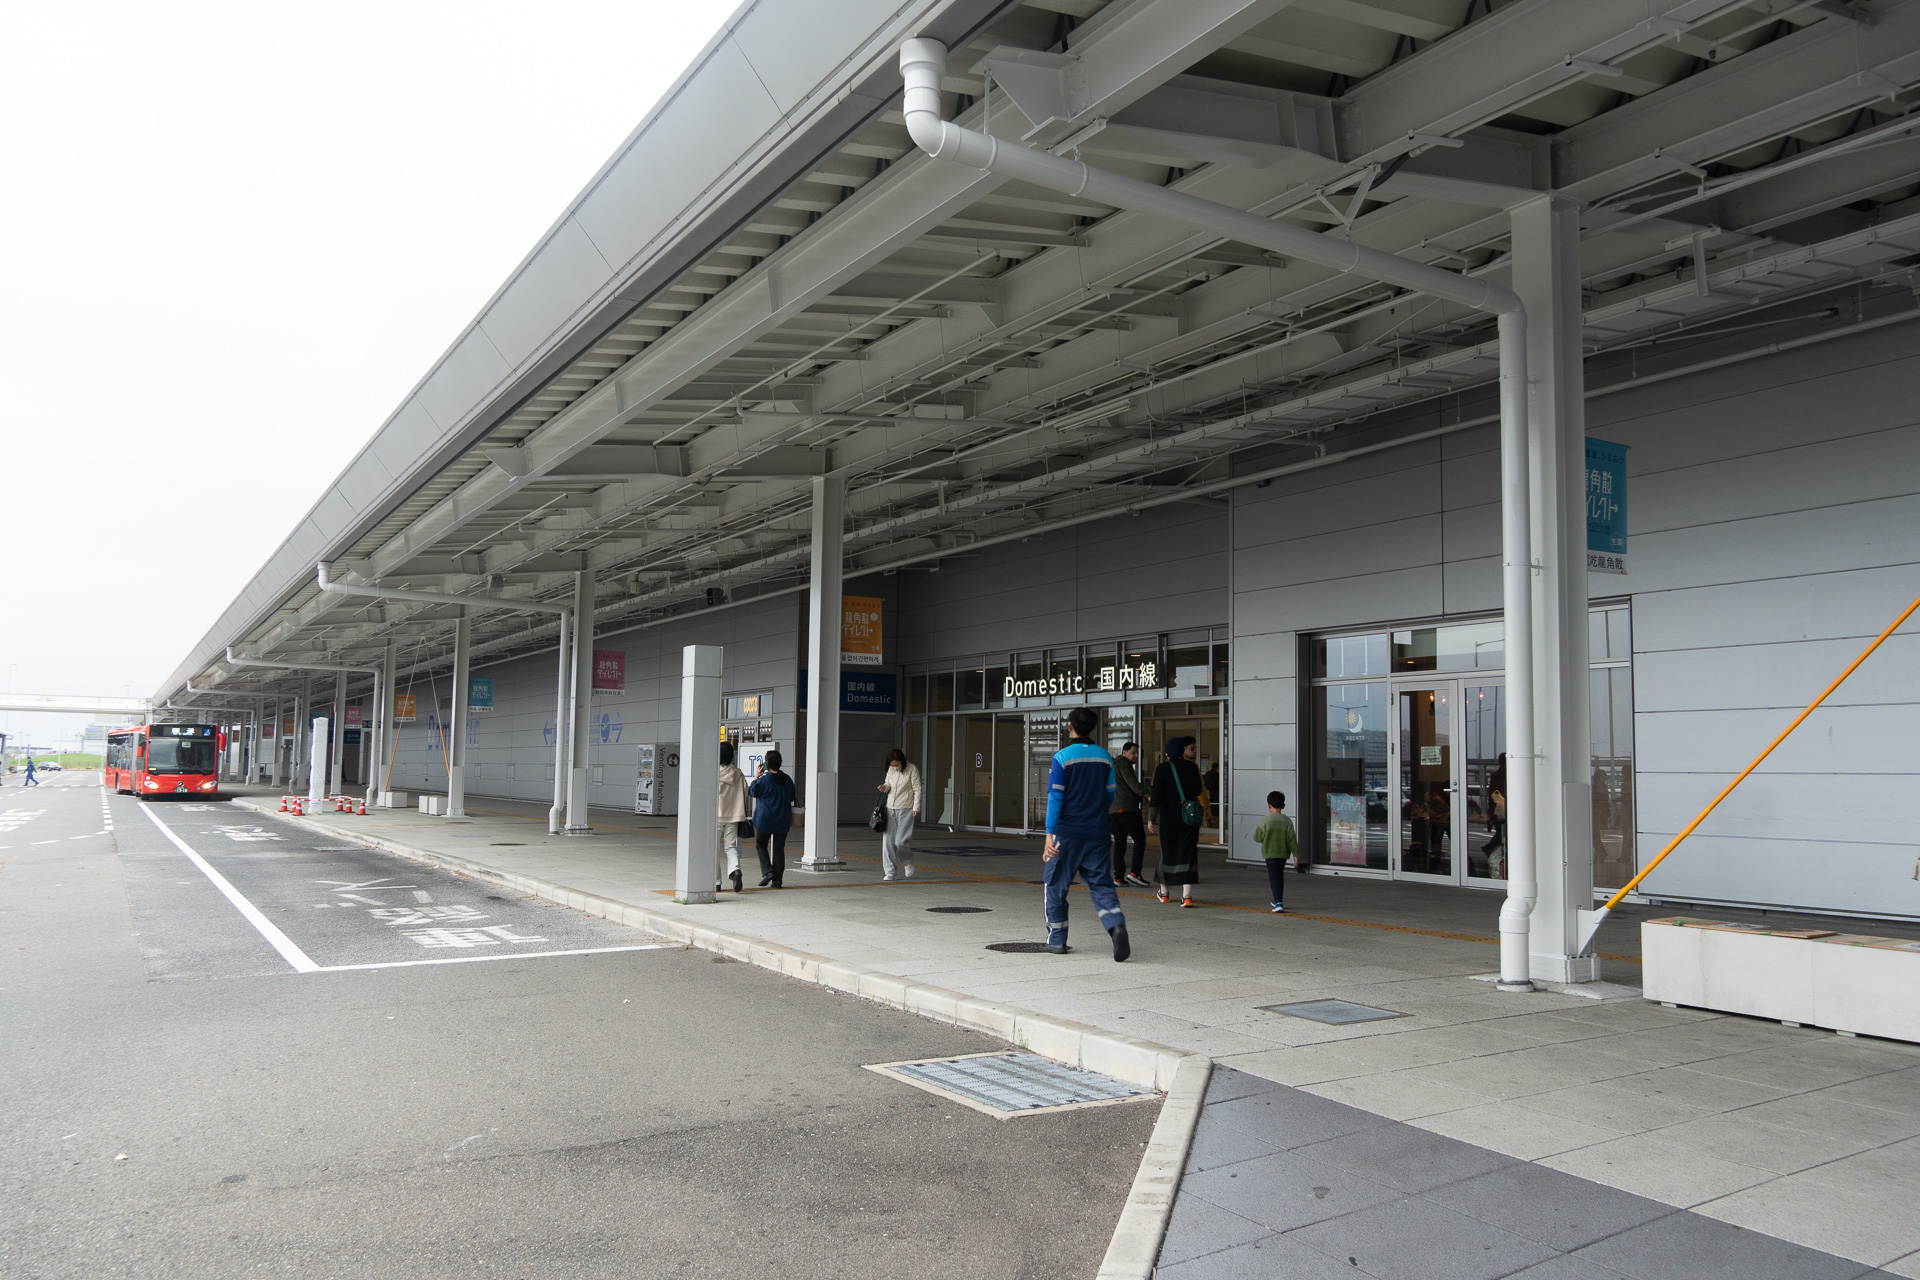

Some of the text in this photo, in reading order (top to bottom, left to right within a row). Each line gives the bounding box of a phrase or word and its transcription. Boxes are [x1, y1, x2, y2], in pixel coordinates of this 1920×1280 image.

[847, 681, 875, 692] 国内線
[1005, 662, 1156, 697] Domestic 国内線
[847, 693, 891, 704] Domestic
[976, 752, 983, 768] B
[656, 747, 666, 813] Vending Machine
